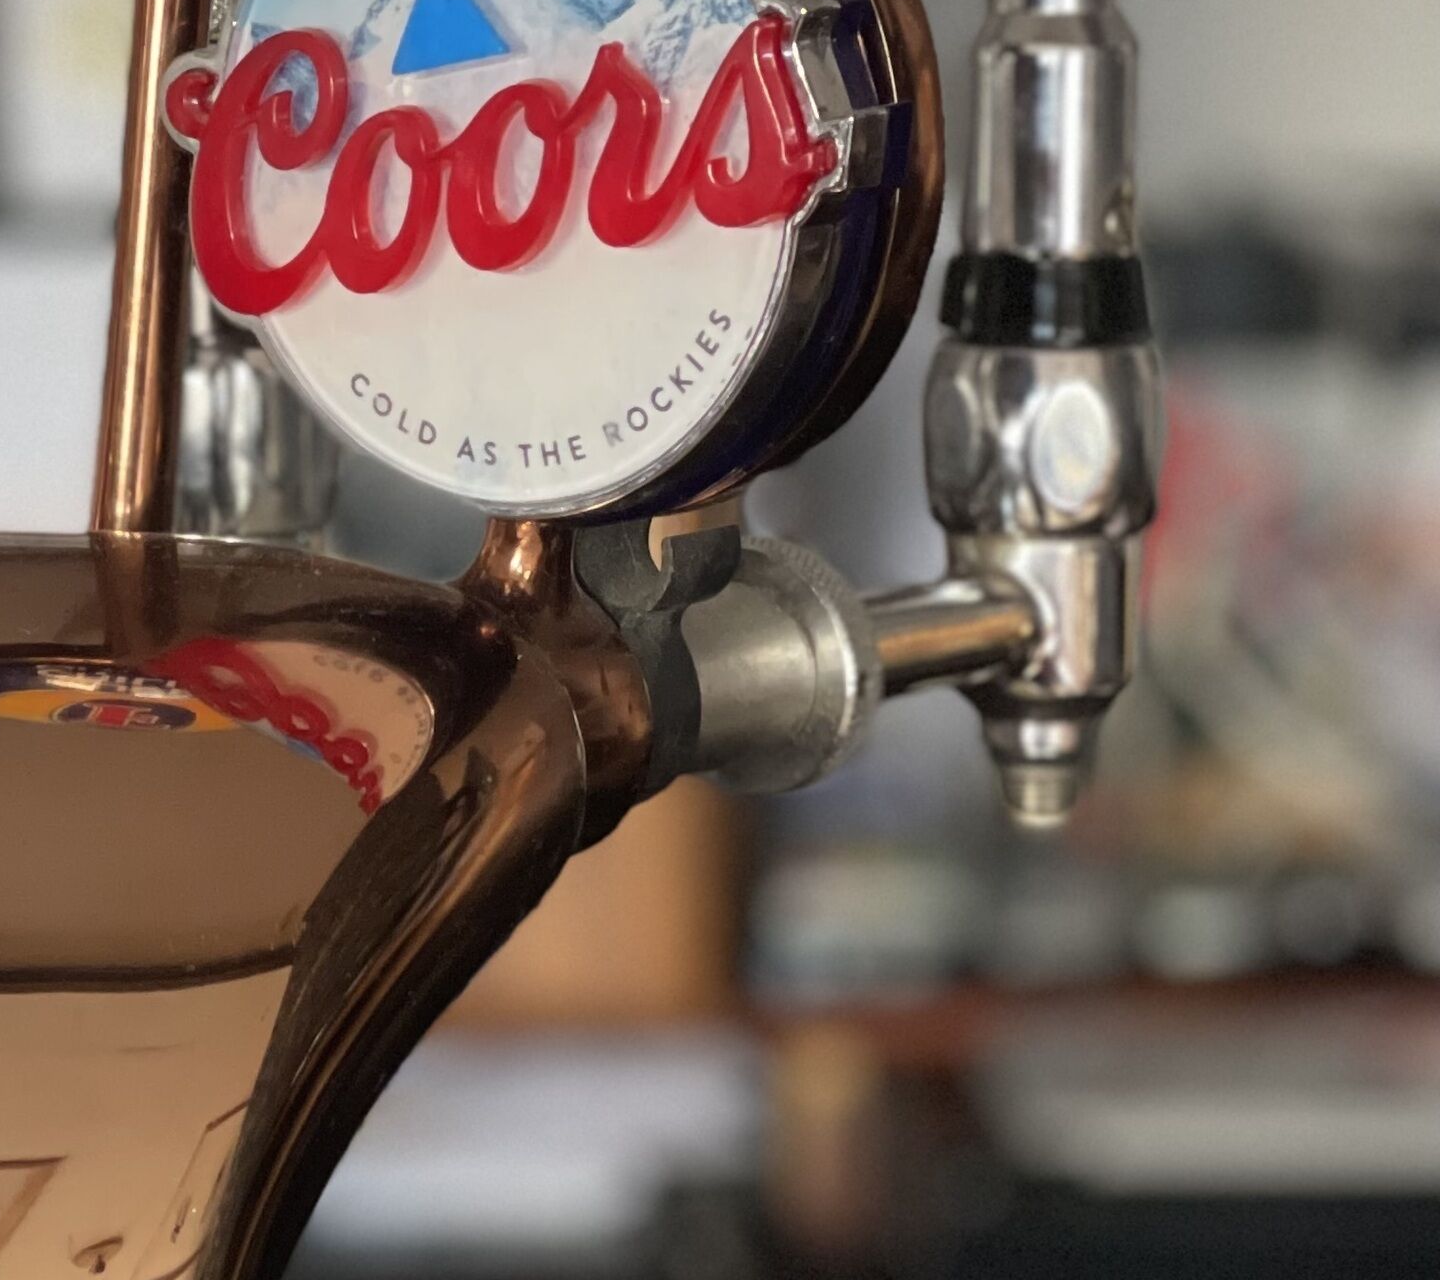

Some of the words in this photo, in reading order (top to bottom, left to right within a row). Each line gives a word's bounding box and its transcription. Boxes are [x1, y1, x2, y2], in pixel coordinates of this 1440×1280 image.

[165, 12, 840, 316] Coors
[349, 372, 439, 446] COLD
[456, 435, 498, 467] AS
[518, 434, 587, 468] THE
[601, 308, 733, 447] ROCKIES
